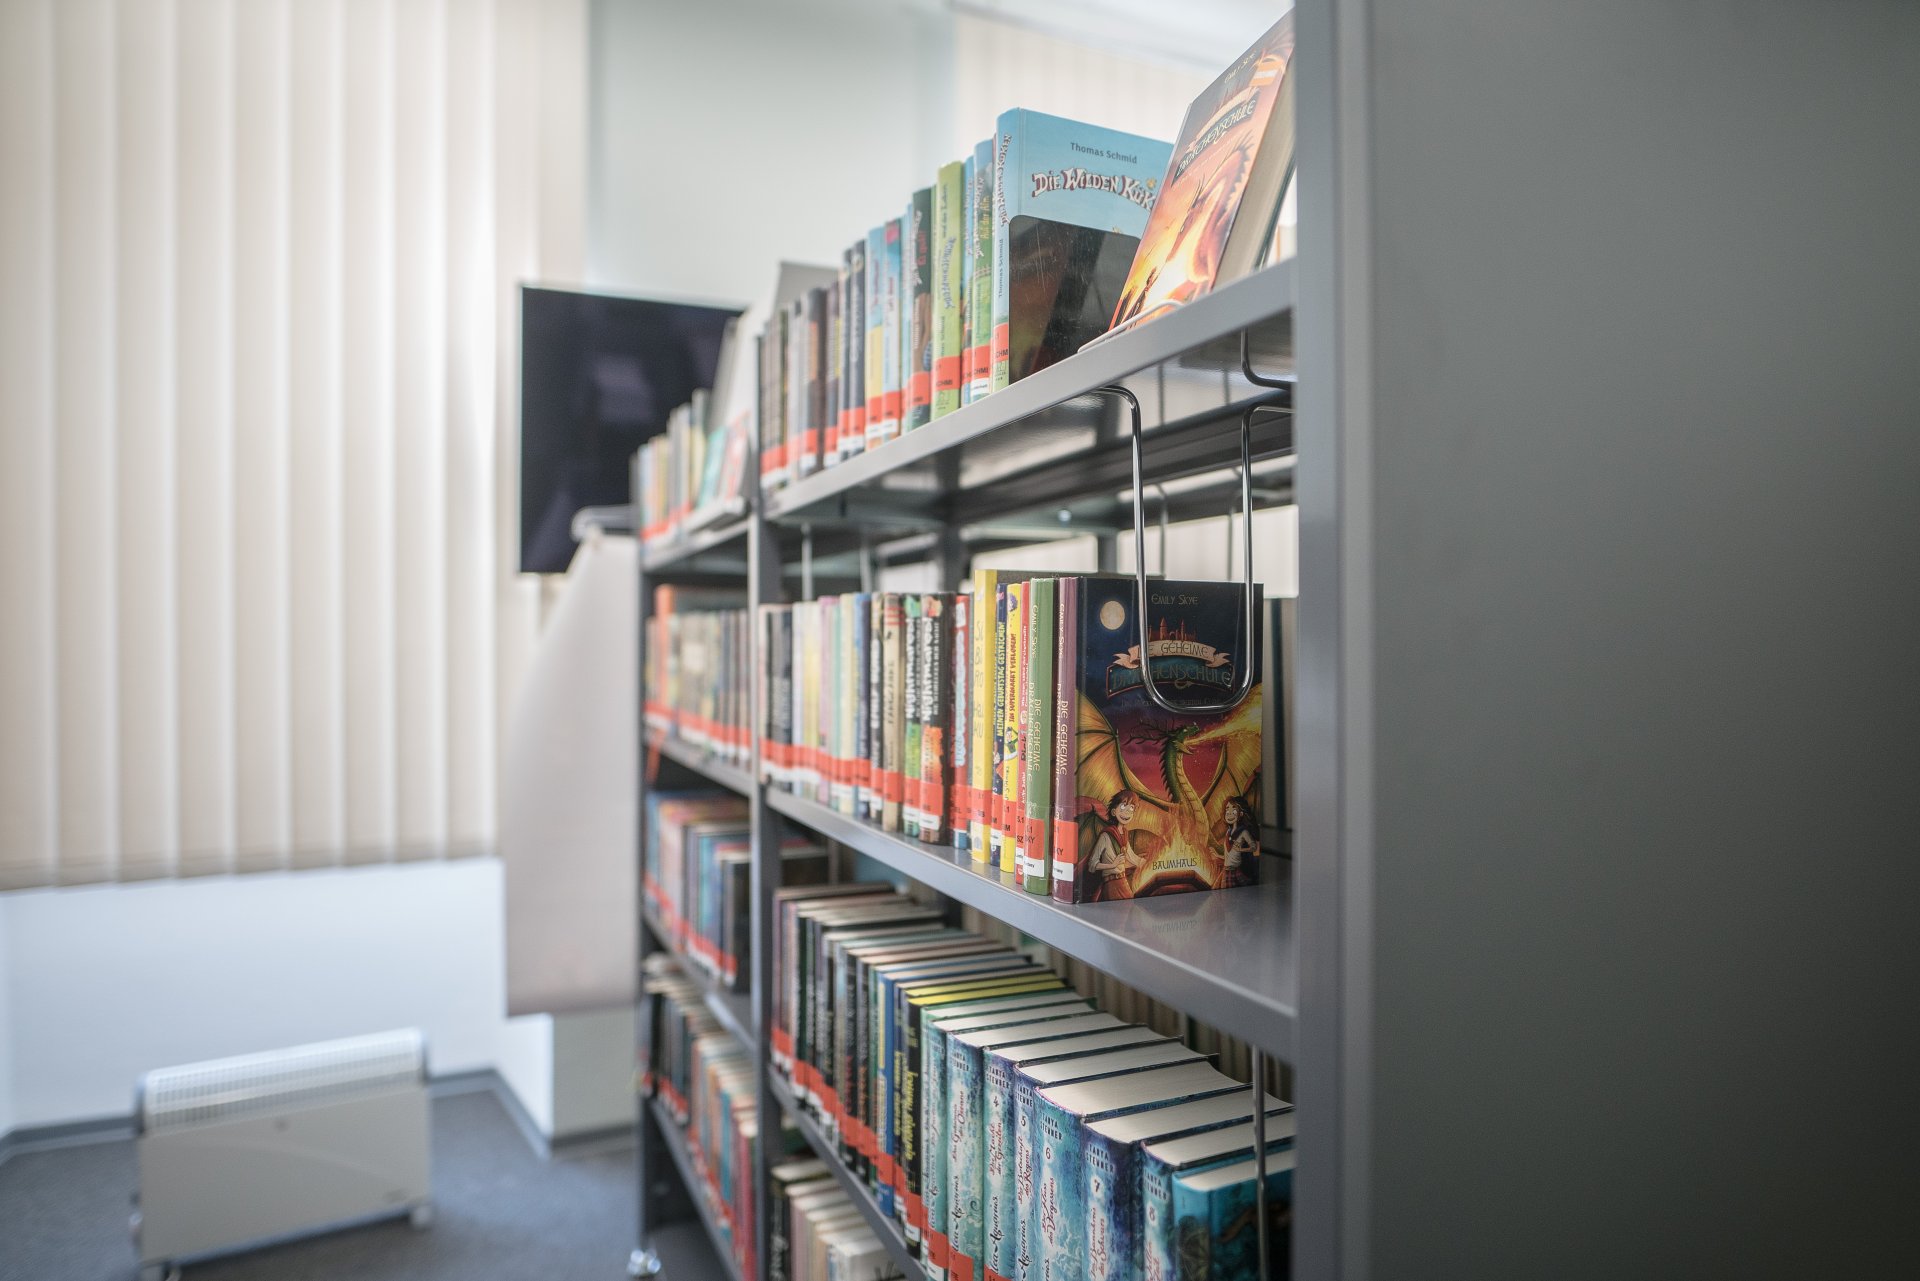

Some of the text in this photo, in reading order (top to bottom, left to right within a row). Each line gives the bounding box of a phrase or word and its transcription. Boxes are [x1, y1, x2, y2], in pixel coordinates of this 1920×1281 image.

[1069, 142, 1138, 164] Thomas Schmid
[1118, 174, 1157, 212] KÜK
[1151, 593, 1200, 605] EMILY SKYE
[1160, 641, 1209, 657] GEHEIME
[905, 618, 915, 719] Nightmares!
[921, 617, 933, 722] Nightmares!
[996, 621, 1006, 737] MEINEN GEBURTSTAG GESTRICHEN!
[1112, 662, 1233, 690] DRAHENSCHULE
[1009, 713, 1015, 723] IM
[1033, 721, 1041, 772] GEHEIME
[1059, 700, 1069, 776] DIE GEHEIME
[1152, 857, 1198, 871] BAUMHAUS
[986, 1073, 1011, 1089] STEWNER
[989, 1065, 1006, 1079] TANYA
[1015, 1092, 1033, 1108] STEWNE
[1017, 1083, 1033, 1097] TANYA
[957, 1090, 966, 1125] Ozeane
[993, 1096, 999, 1107] 4
[951, 1103, 961, 1144] Geheimnis
[1020, 1116, 1026, 1127] 5
[1040, 1121, 1063, 1141] STEWNER
[1042, 1113, 1059, 1130] TANYA
[1045, 1147, 1051, 1160] 6
[1086, 1152, 1115, 1174] STEWNER
[1089, 1143, 1109, 1161] TANYA
[1023, 1149, 1033, 1185] Regens
[1094, 1179, 1100, 1193] 7
[951, 1175, 965, 1222] Aquarius
[1046, 1177, 1058, 1232] Vergessens
[989, 1195, 1005, 1245] Aquarius
[1149, 1207, 1156, 1222] 8
[1017, 1219, 1032, 1268] Aquarius
[1090, 1207, 1098, 1262] Bannkreis
[1097, 1218, 1107, 1262] Schwurs
